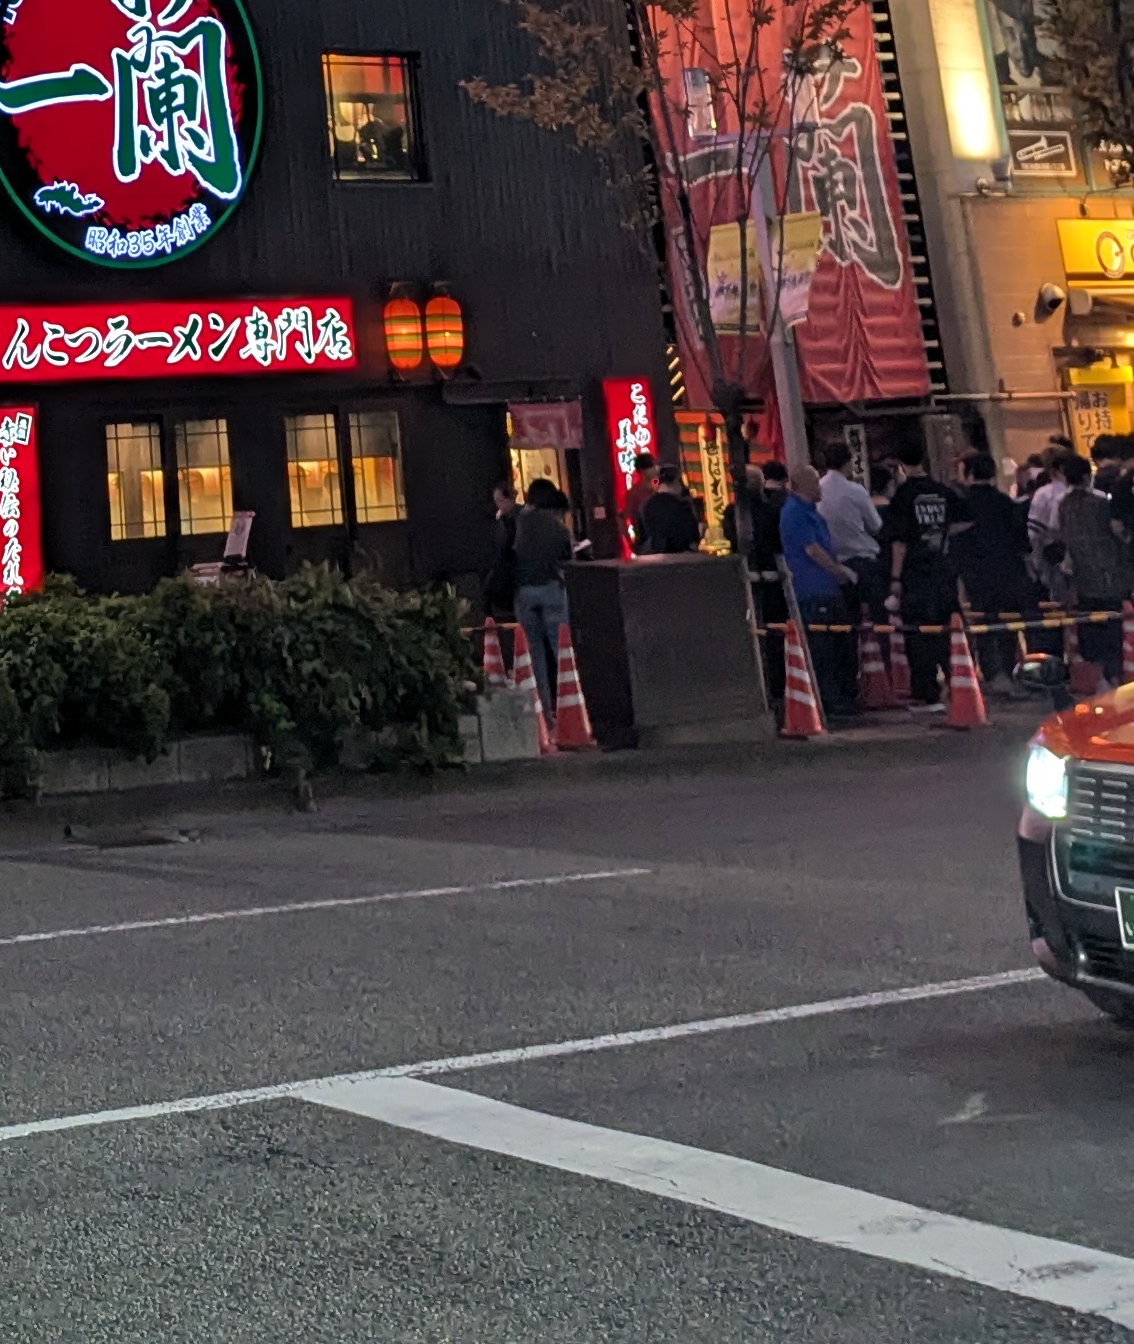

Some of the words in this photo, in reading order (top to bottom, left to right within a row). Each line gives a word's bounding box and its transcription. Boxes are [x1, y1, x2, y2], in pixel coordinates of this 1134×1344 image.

[85, 203, 211, 258] 昭和35年創業
